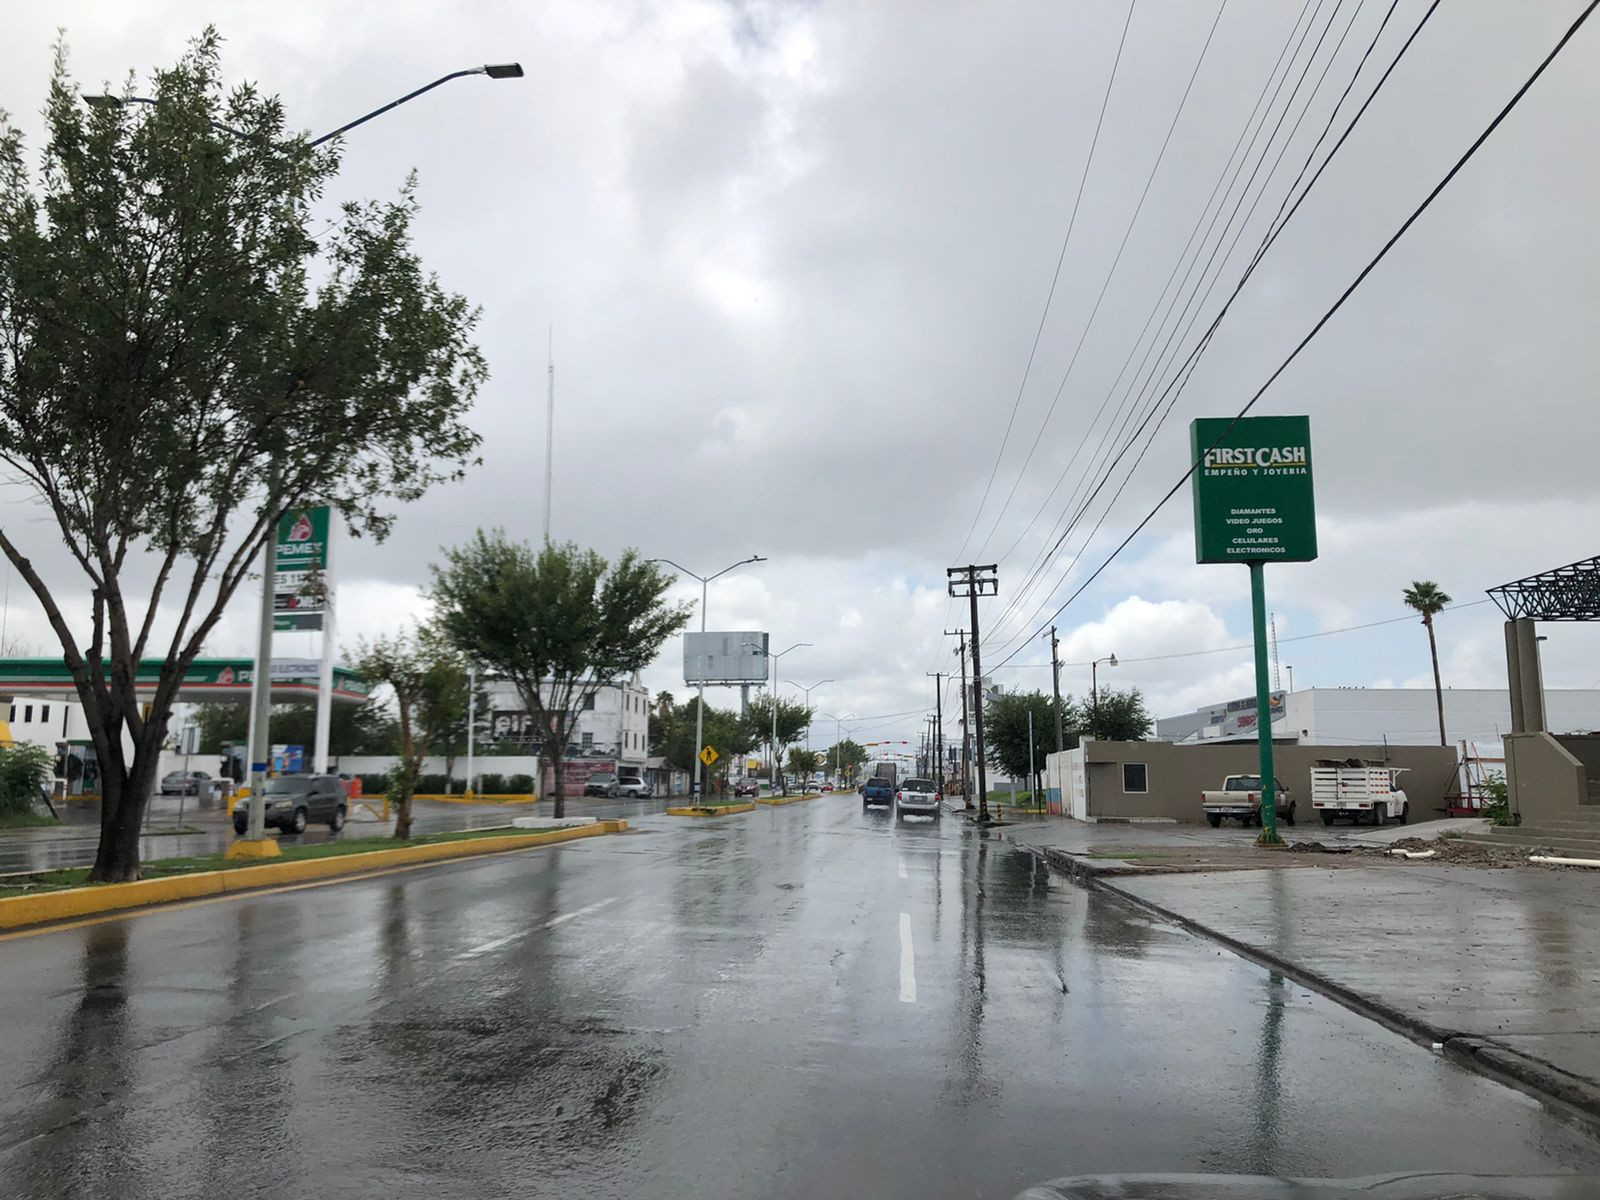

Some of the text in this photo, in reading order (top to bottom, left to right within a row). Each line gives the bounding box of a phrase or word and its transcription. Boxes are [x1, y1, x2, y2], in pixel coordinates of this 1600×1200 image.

[1204, 467, 1307, 476] EMPEÑO Y JOYERIA
[1251, 517, 1283, 525] JUEGOS
[1226, 546, 1286, 554] ELECTRONICOS
